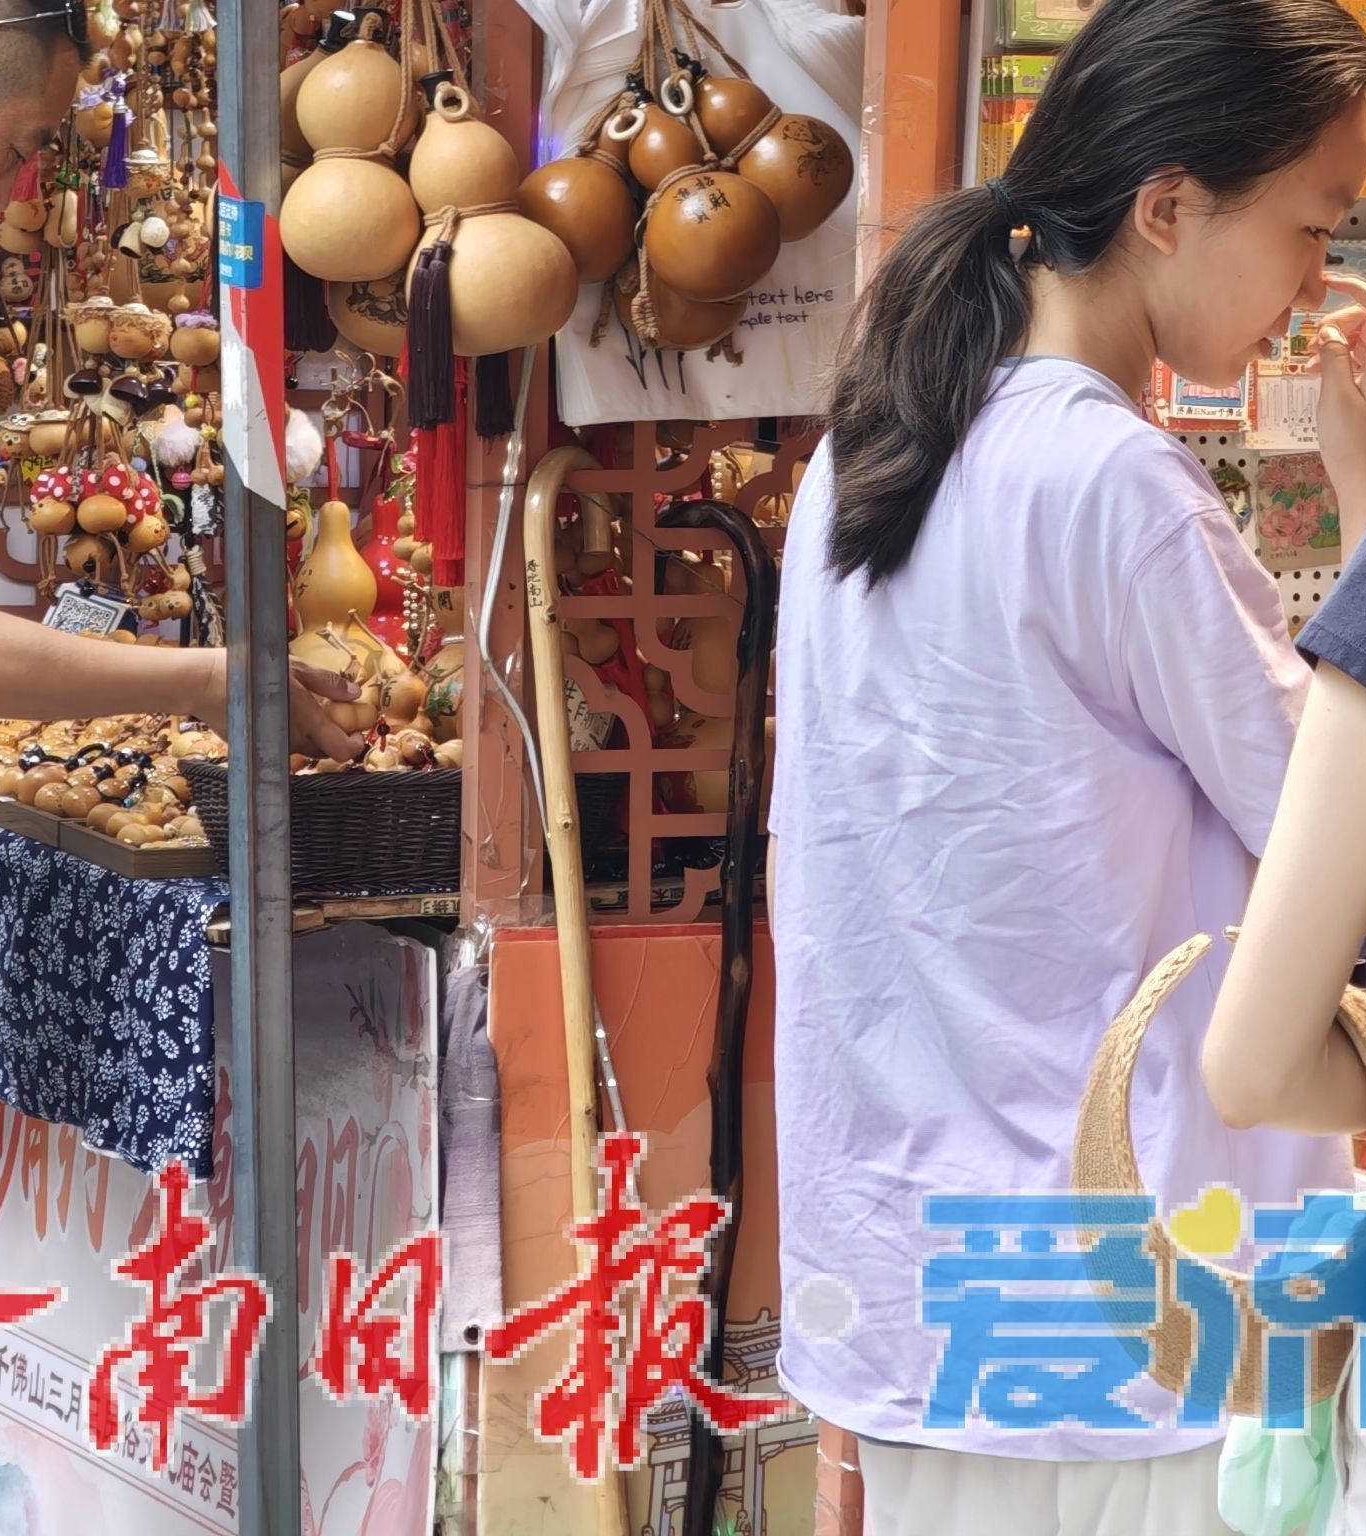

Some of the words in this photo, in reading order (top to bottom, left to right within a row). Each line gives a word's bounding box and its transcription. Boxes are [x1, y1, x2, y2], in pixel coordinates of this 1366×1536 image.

[747, 288, 789, 306] text
[794, 286, 834, 302] here
[776, 311, 809, 324] text
